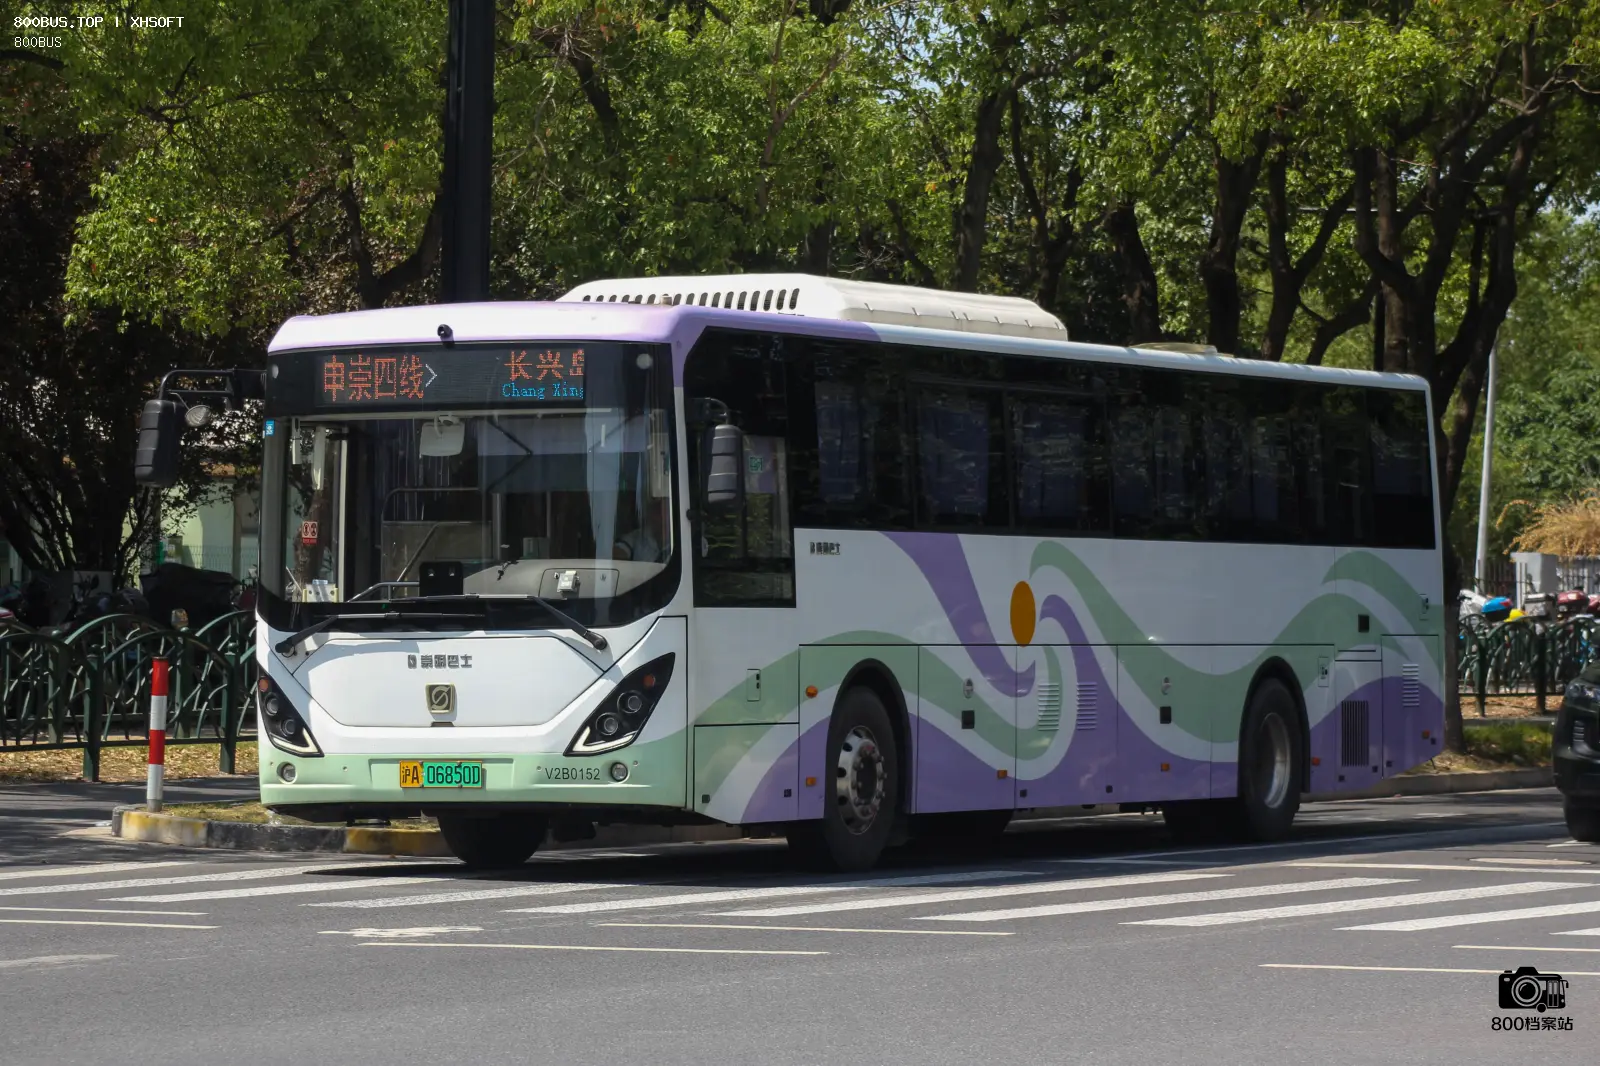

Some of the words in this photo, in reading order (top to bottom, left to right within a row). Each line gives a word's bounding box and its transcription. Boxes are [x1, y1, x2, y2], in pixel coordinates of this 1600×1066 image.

[323, 354, 425, 402] 申崇四线
[502, 382, 546, 400] Chang
[545, 767, 601, 781] V2B0152
